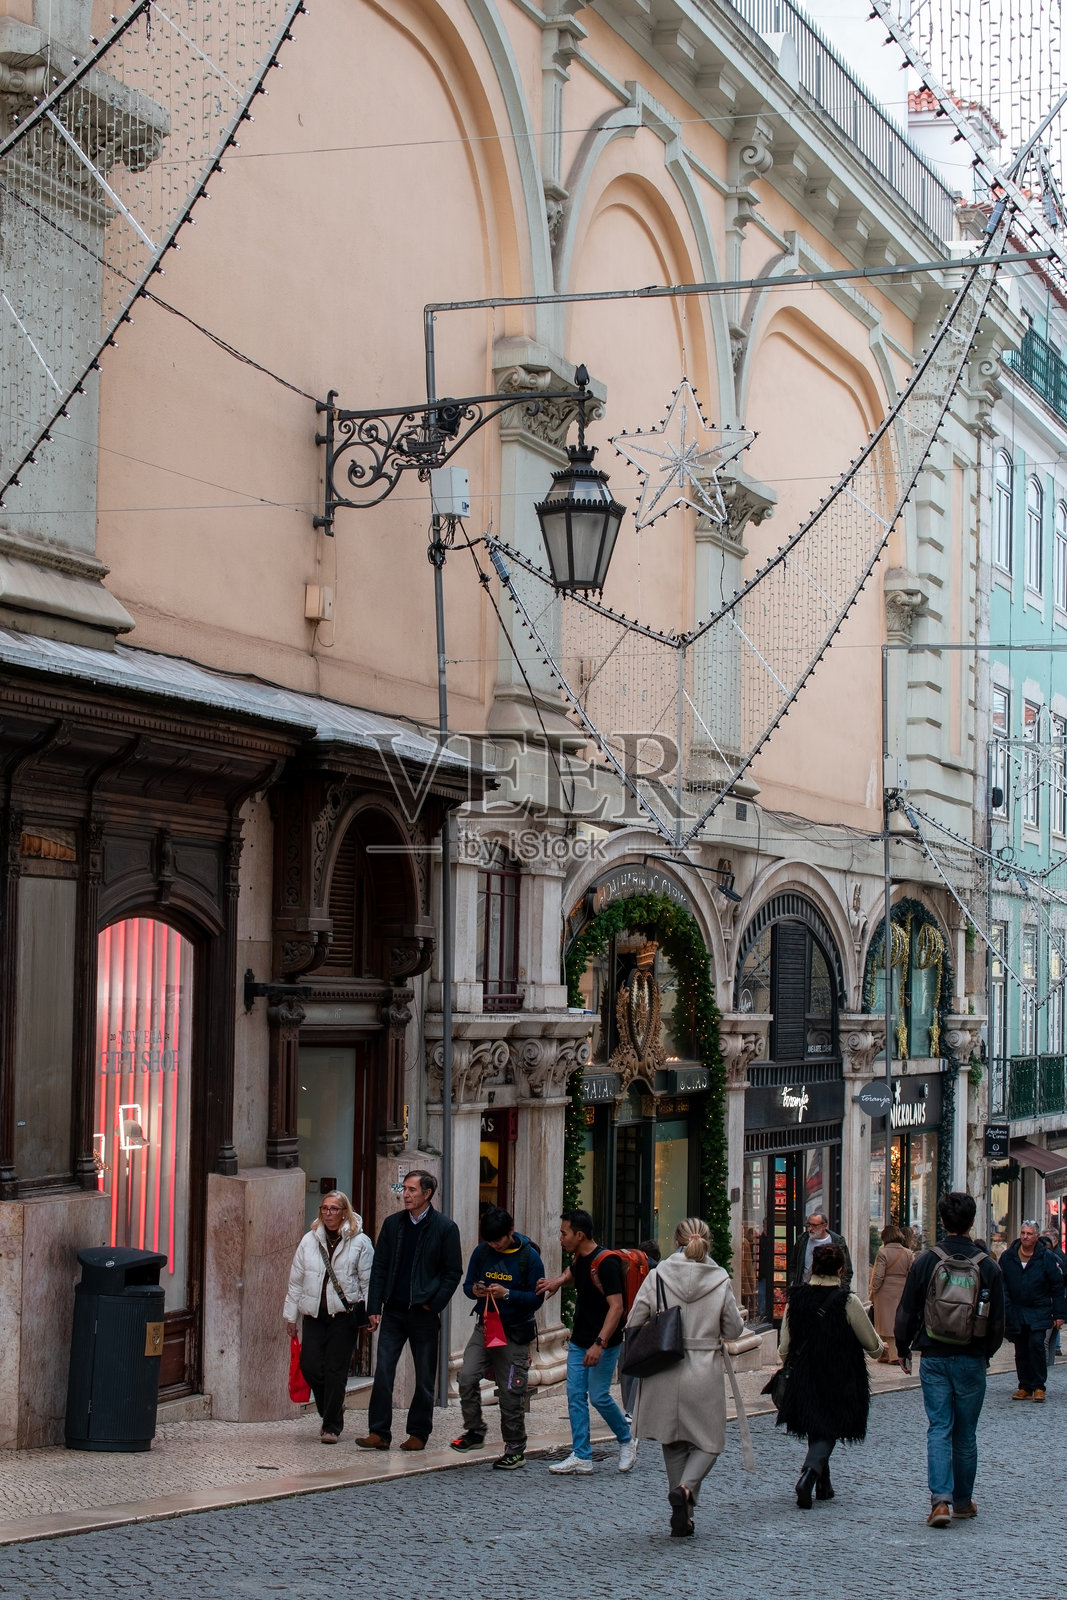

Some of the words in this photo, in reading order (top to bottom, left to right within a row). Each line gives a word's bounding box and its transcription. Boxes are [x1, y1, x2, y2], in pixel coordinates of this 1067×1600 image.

[118, 1031, 142, 1045] NEW
[98, 1051, 137, 1074] GIFT
[141, 1050, 183, 1073] SHOP
[861, 1094, 891, 1108] toranja
[890, 1102, 926, 1129] NICKOLAUS
[485, 1271, 513, 1281] adidas
